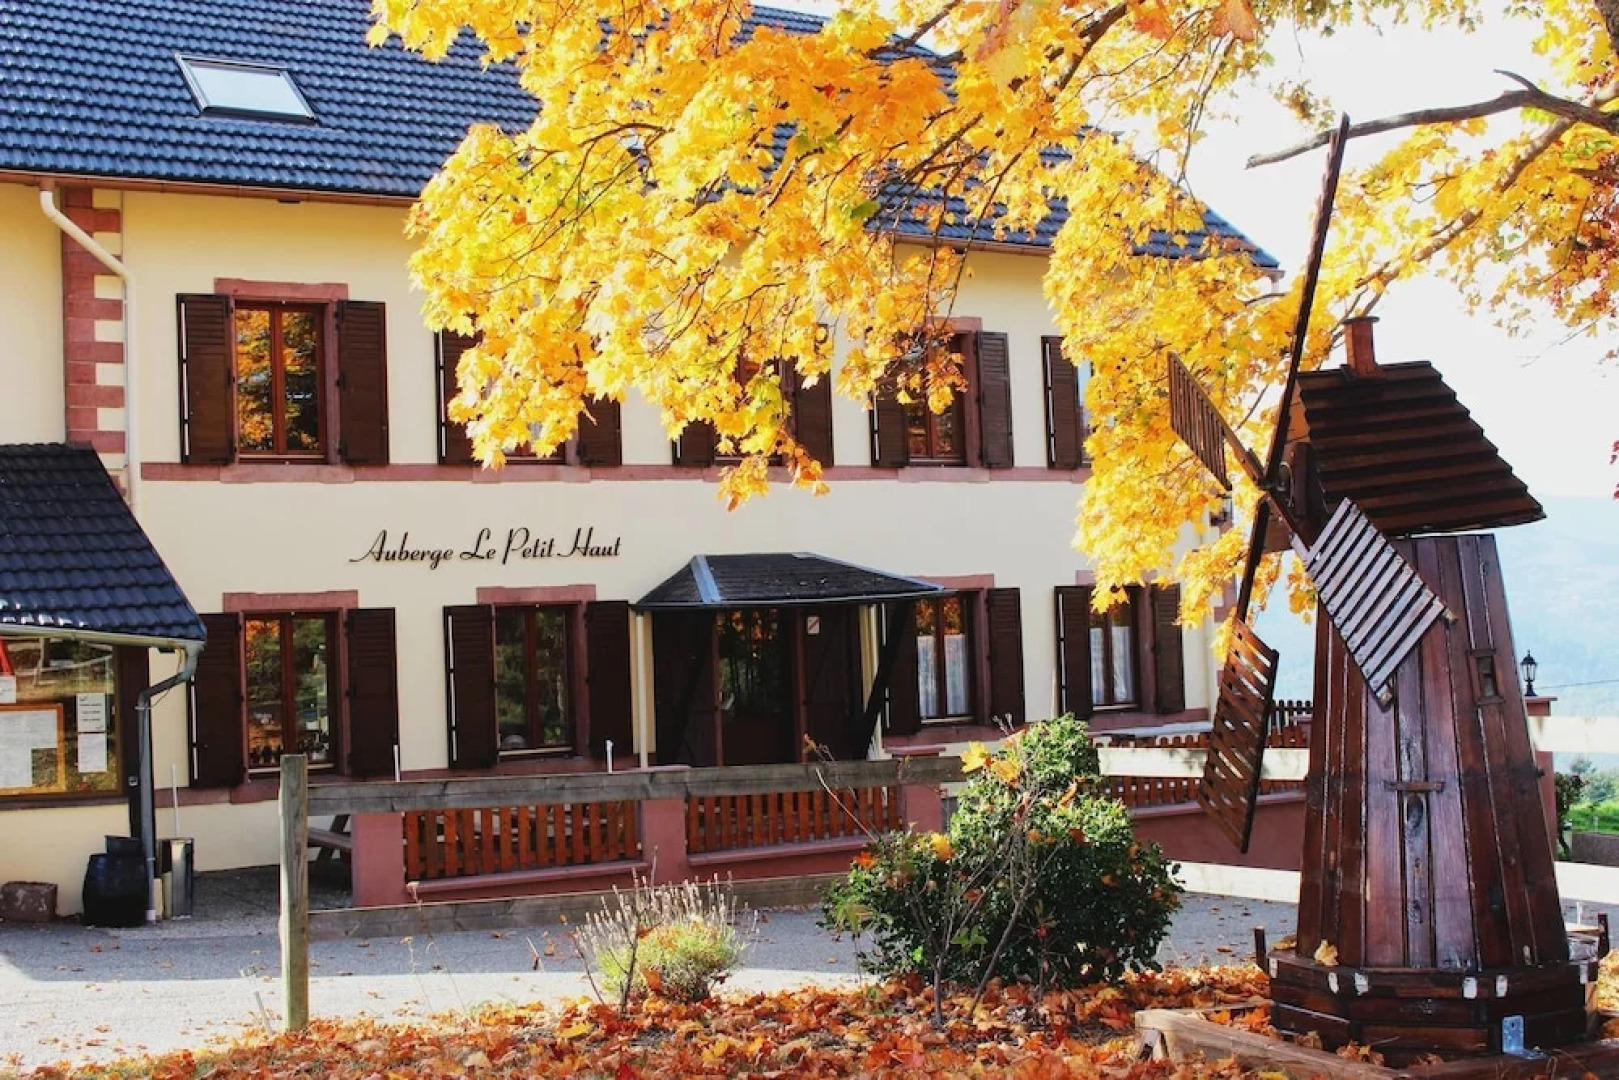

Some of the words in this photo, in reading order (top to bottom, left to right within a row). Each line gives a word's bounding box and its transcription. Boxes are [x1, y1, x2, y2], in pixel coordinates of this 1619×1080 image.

[349, 529, 454, 570] Auberge
[459, 527, 496, 560] Le
[502, 527, 554, 565] Petit
[556, 526, 621, 558] Haut
